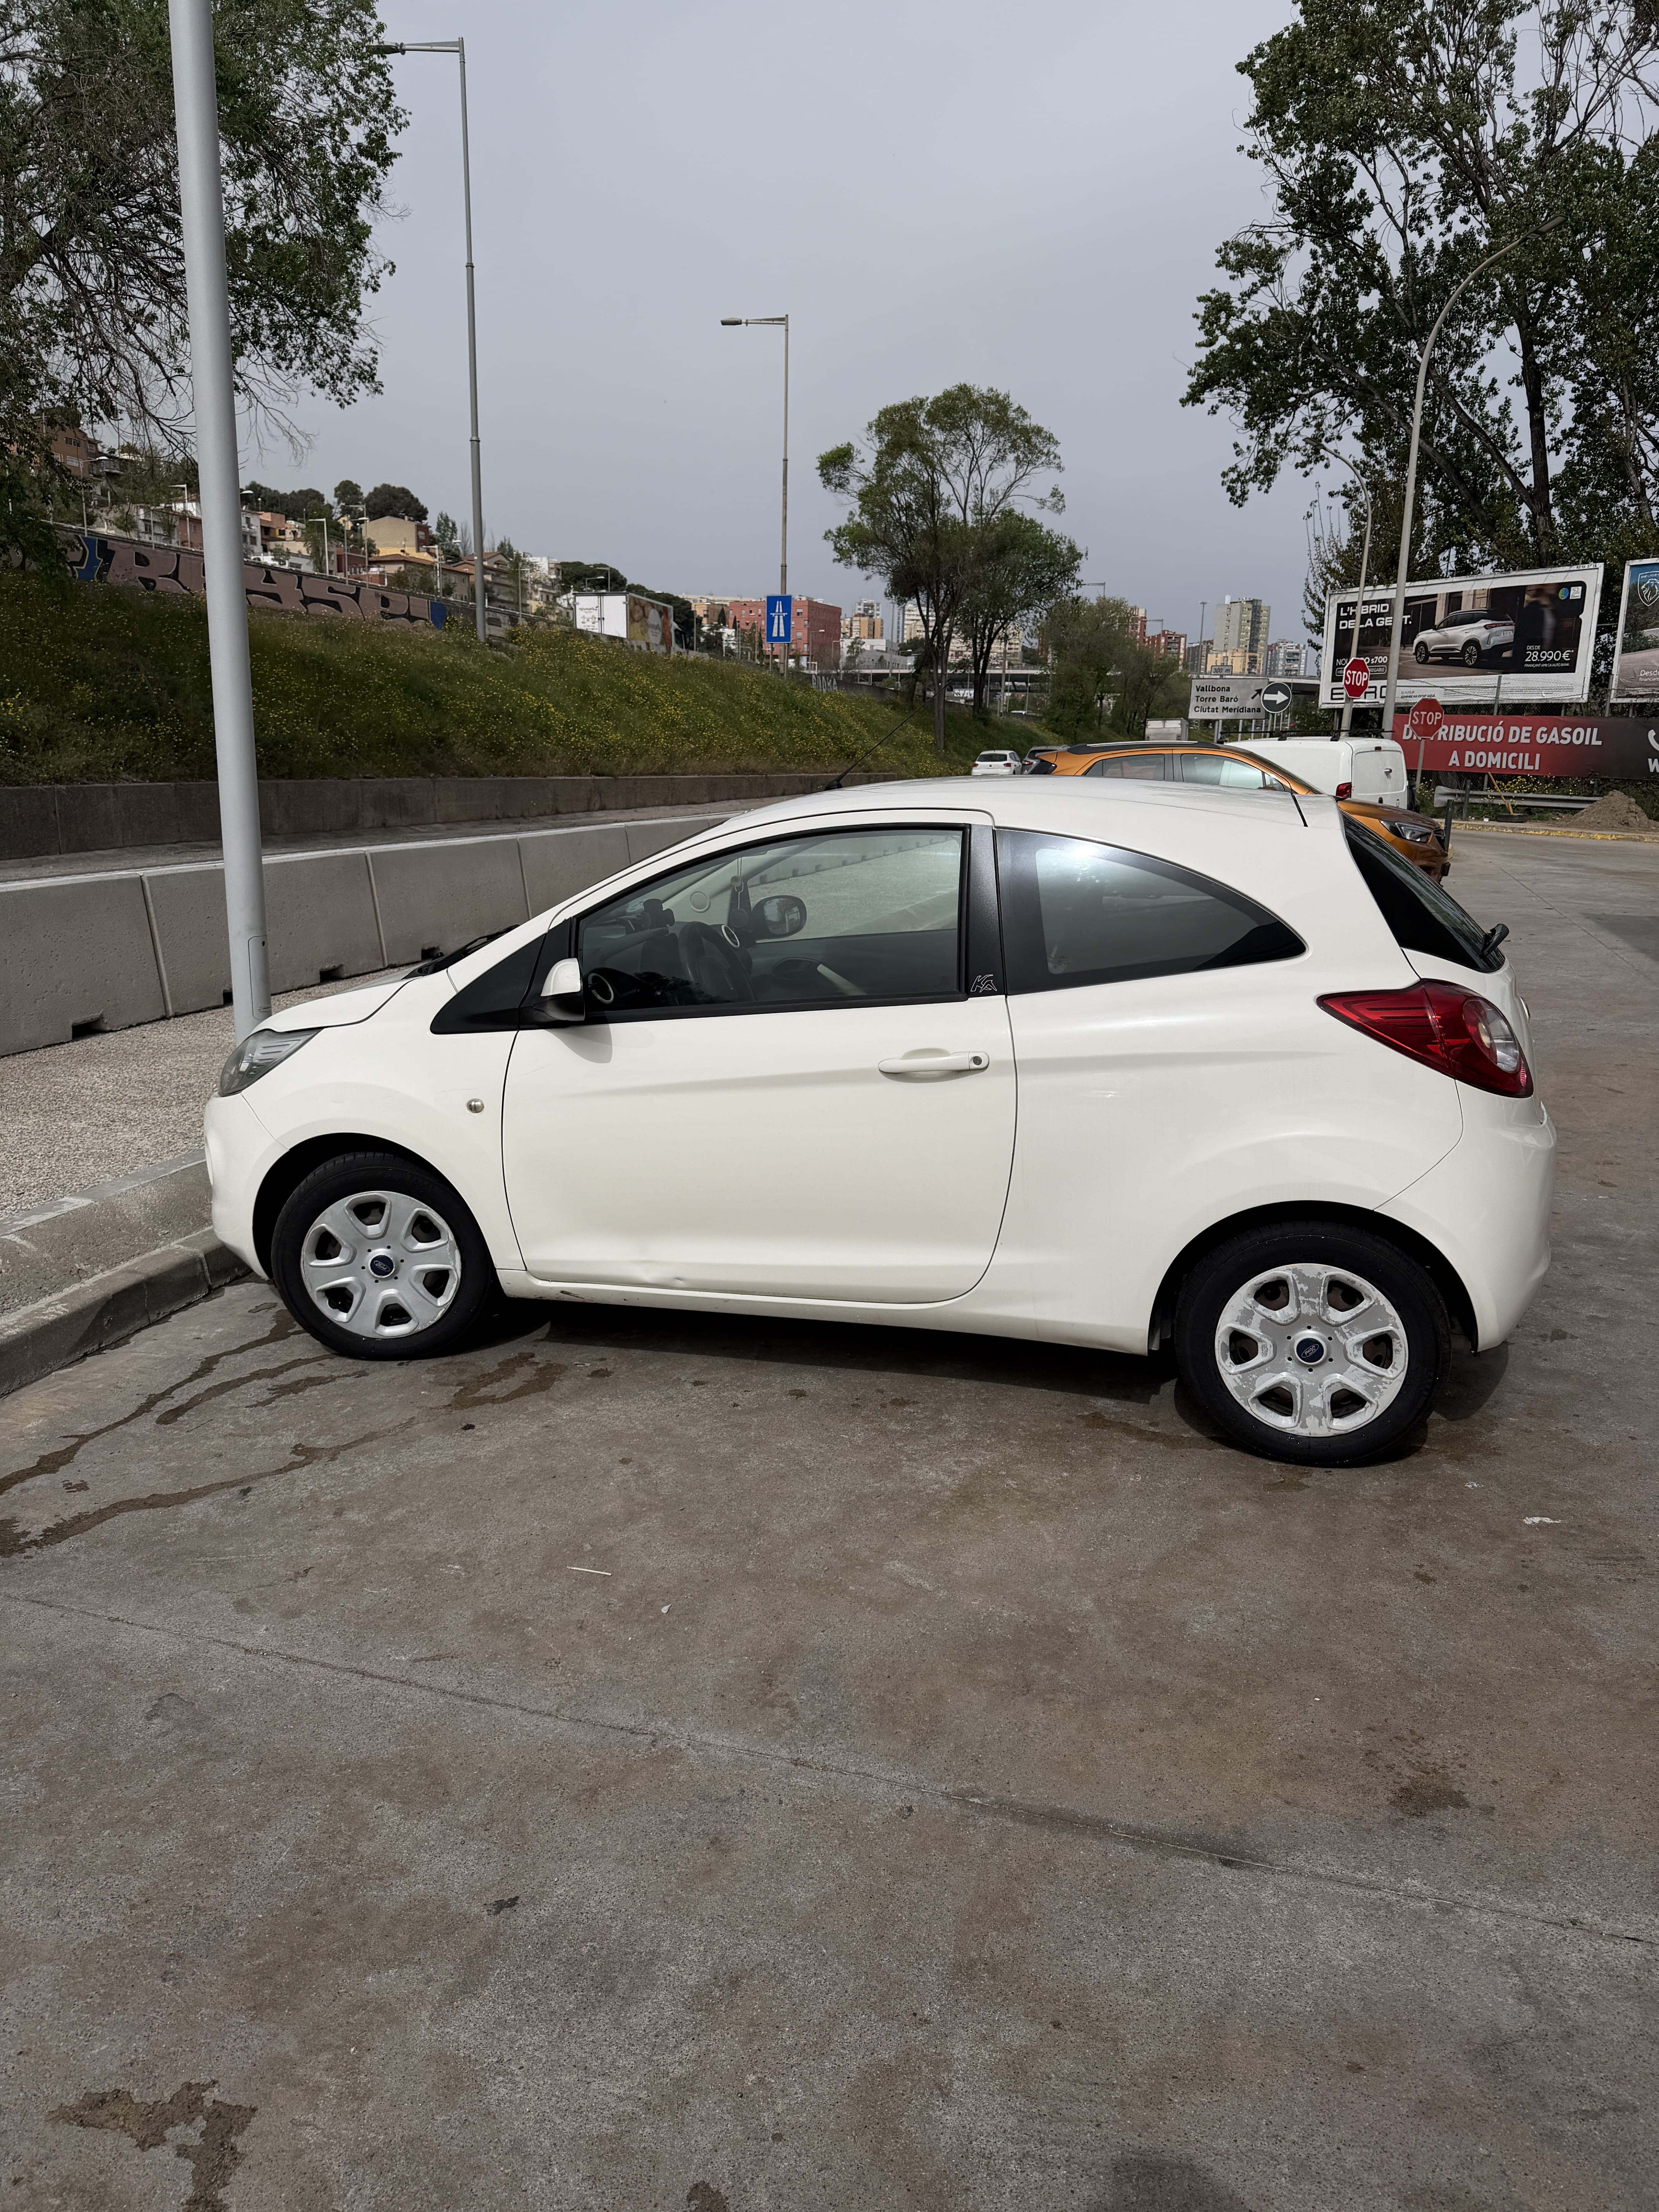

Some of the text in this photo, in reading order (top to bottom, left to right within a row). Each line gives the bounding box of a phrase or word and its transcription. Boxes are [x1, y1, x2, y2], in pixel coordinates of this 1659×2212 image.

[1340, 603, 1389, 616] L'HBRID
[1339, 620, 1355, 629] DE
[1376, 615, 1412, 627] GET.
[1345, 670, 1368, 686] STOP
[1412, 711, 1442, 725] STOP
[1402, 721, 1602, 745] DRIBUCIÓ DE GASOIL
[1448, 750, 1540, 770] A DOMICILI
